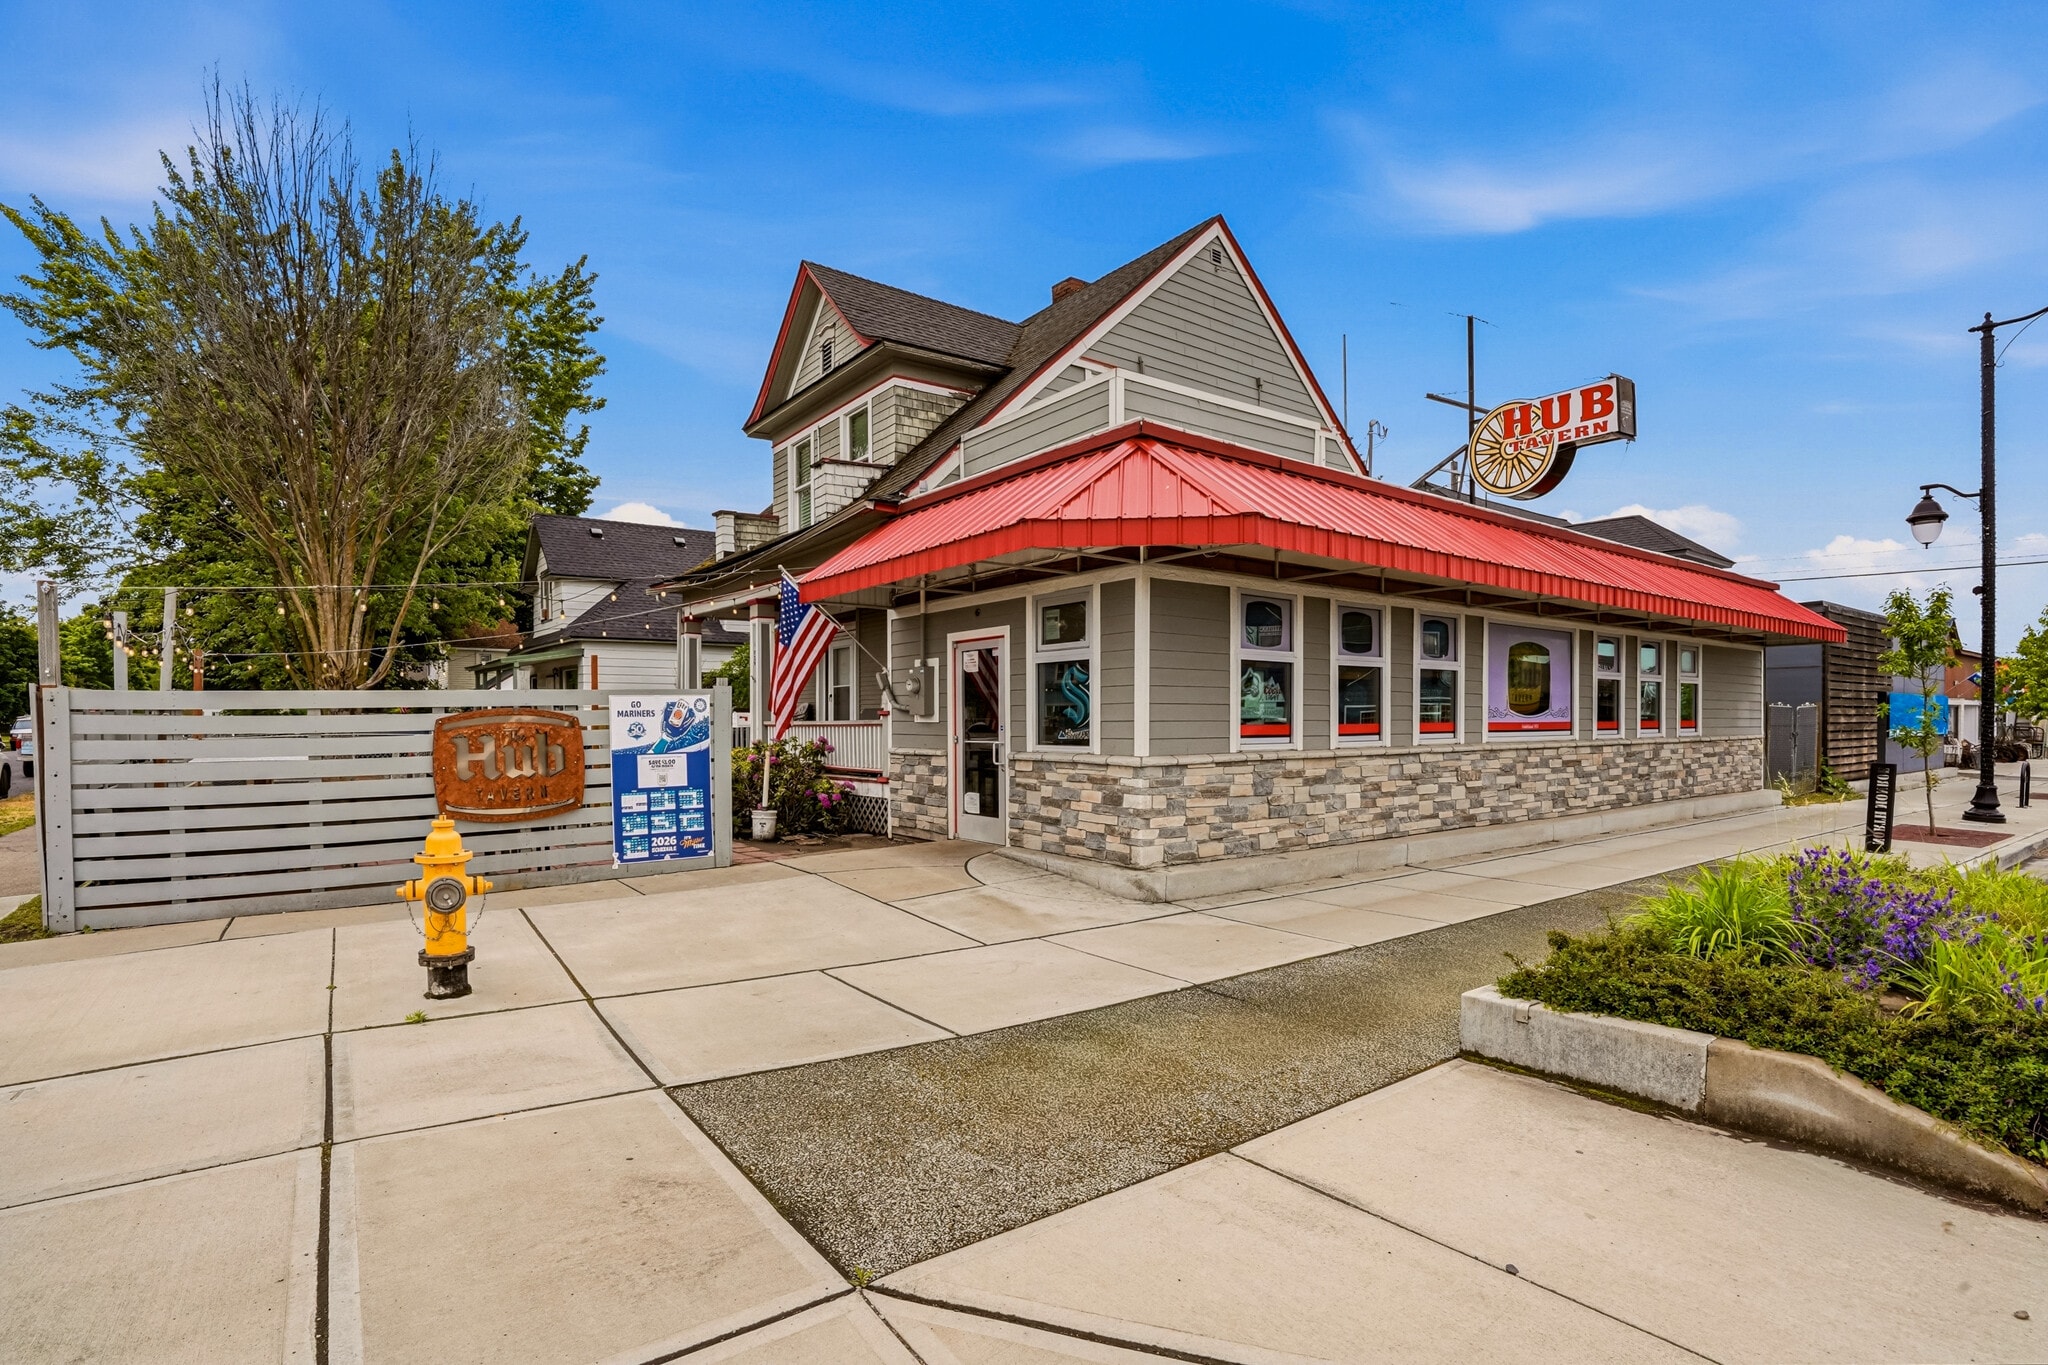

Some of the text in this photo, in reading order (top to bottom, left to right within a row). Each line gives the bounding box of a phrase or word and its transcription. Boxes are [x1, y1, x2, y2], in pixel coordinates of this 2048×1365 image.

[1502, 384, 1614, 440] HUB
[1508, 420, 1609, 453] TAVERN
[630, 700, 642, 709] GO
[616, 709, 656, 718] MARINERS
[451, 729, 565, 782] Hub
[475, 785, 549, 802] TAVERN
[651, 835, 677, 847] 2026
